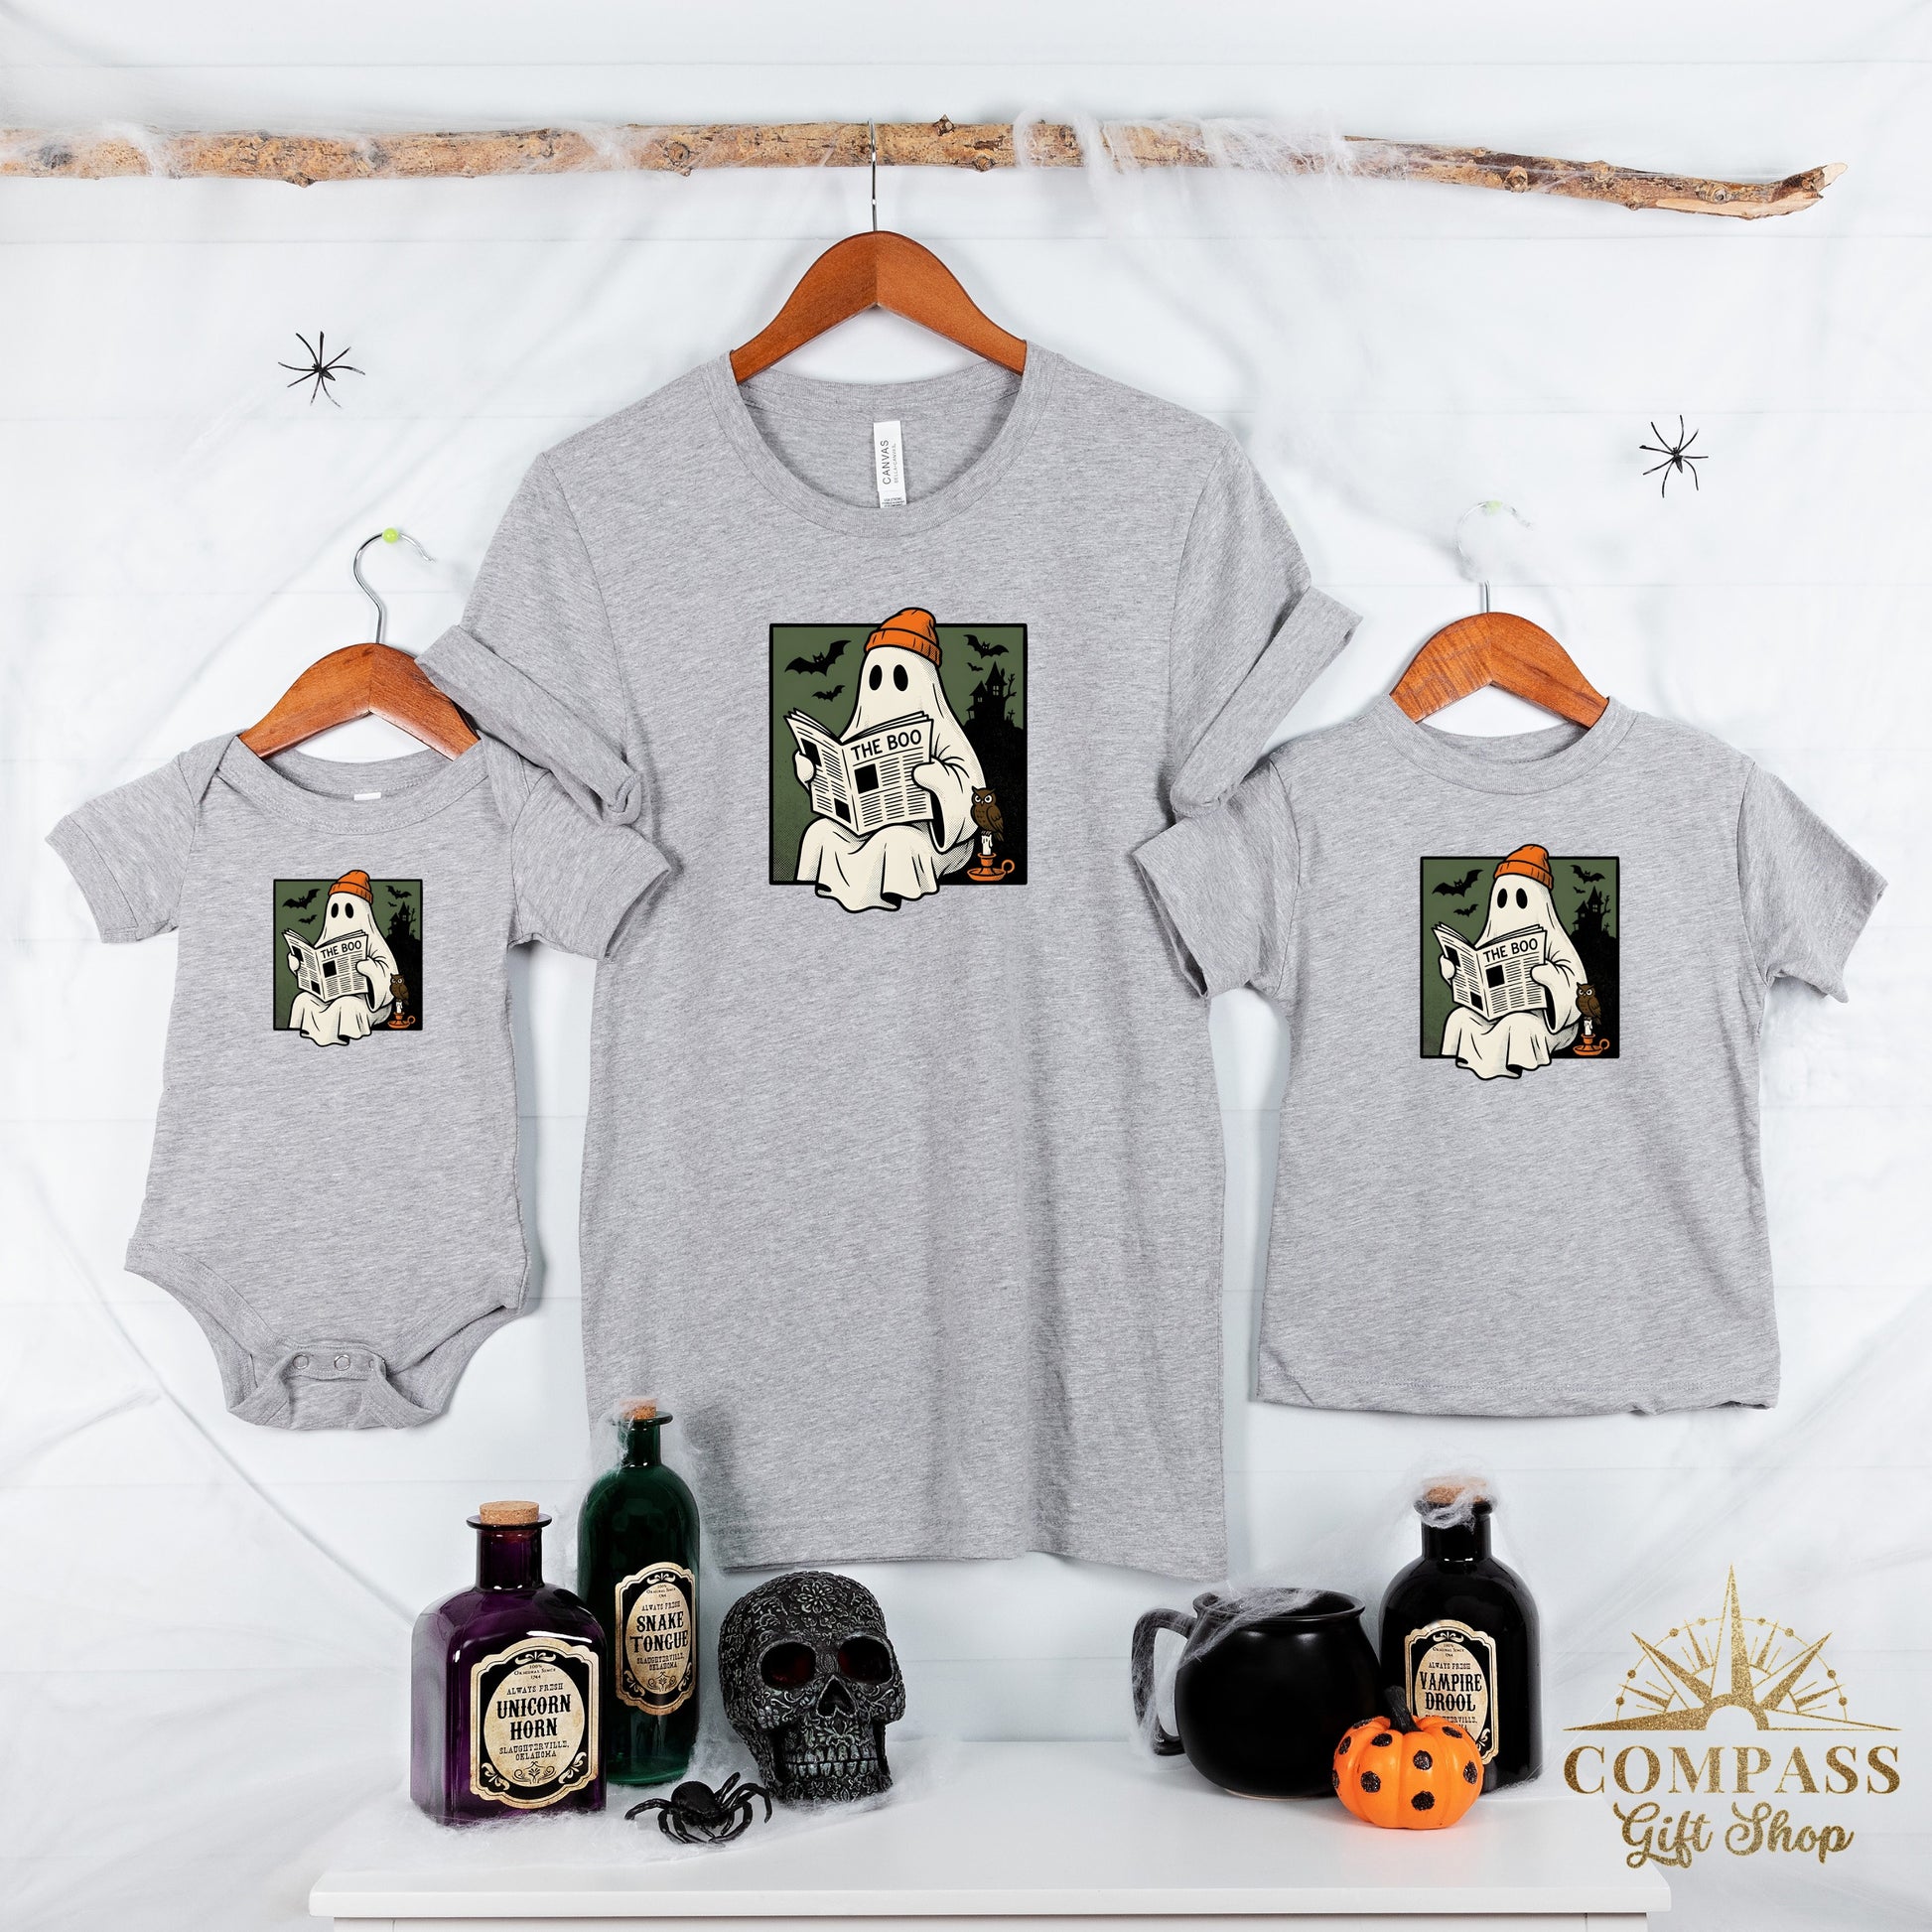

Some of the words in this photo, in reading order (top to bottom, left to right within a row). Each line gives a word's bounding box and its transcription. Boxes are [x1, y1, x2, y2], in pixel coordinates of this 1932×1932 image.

[880, 440, 892, 484] CANVAS
[850, 738, 883, 760] THE
[887, 729, 922, 751] BOO
[320, 945, 339, 959] THE
[341, 940, 361, 953] BOO
[1482, 945, 1508, 962] THE
[1510, 938, 1538, 954] BOO
[636, 1611, 684, 1632] SNAKE
[629, 1630, 689, 1653] TONGUE
[1428, 1661, 1450, 1670] ALWAYS
[506, 1685, 537, 1695] ALWAYS
[539, 1682, 564, 1692] FRESH
[1420, 1671, 1482, 1692] VAMPIRE
[496, 1694, 572, 1719] UNICORN
[1425, 1693, 1476, 1712] DROOL
[509, 1718, 558, 1740] HORN
[515, 1750, 557, 1761] OKLAHOMA
